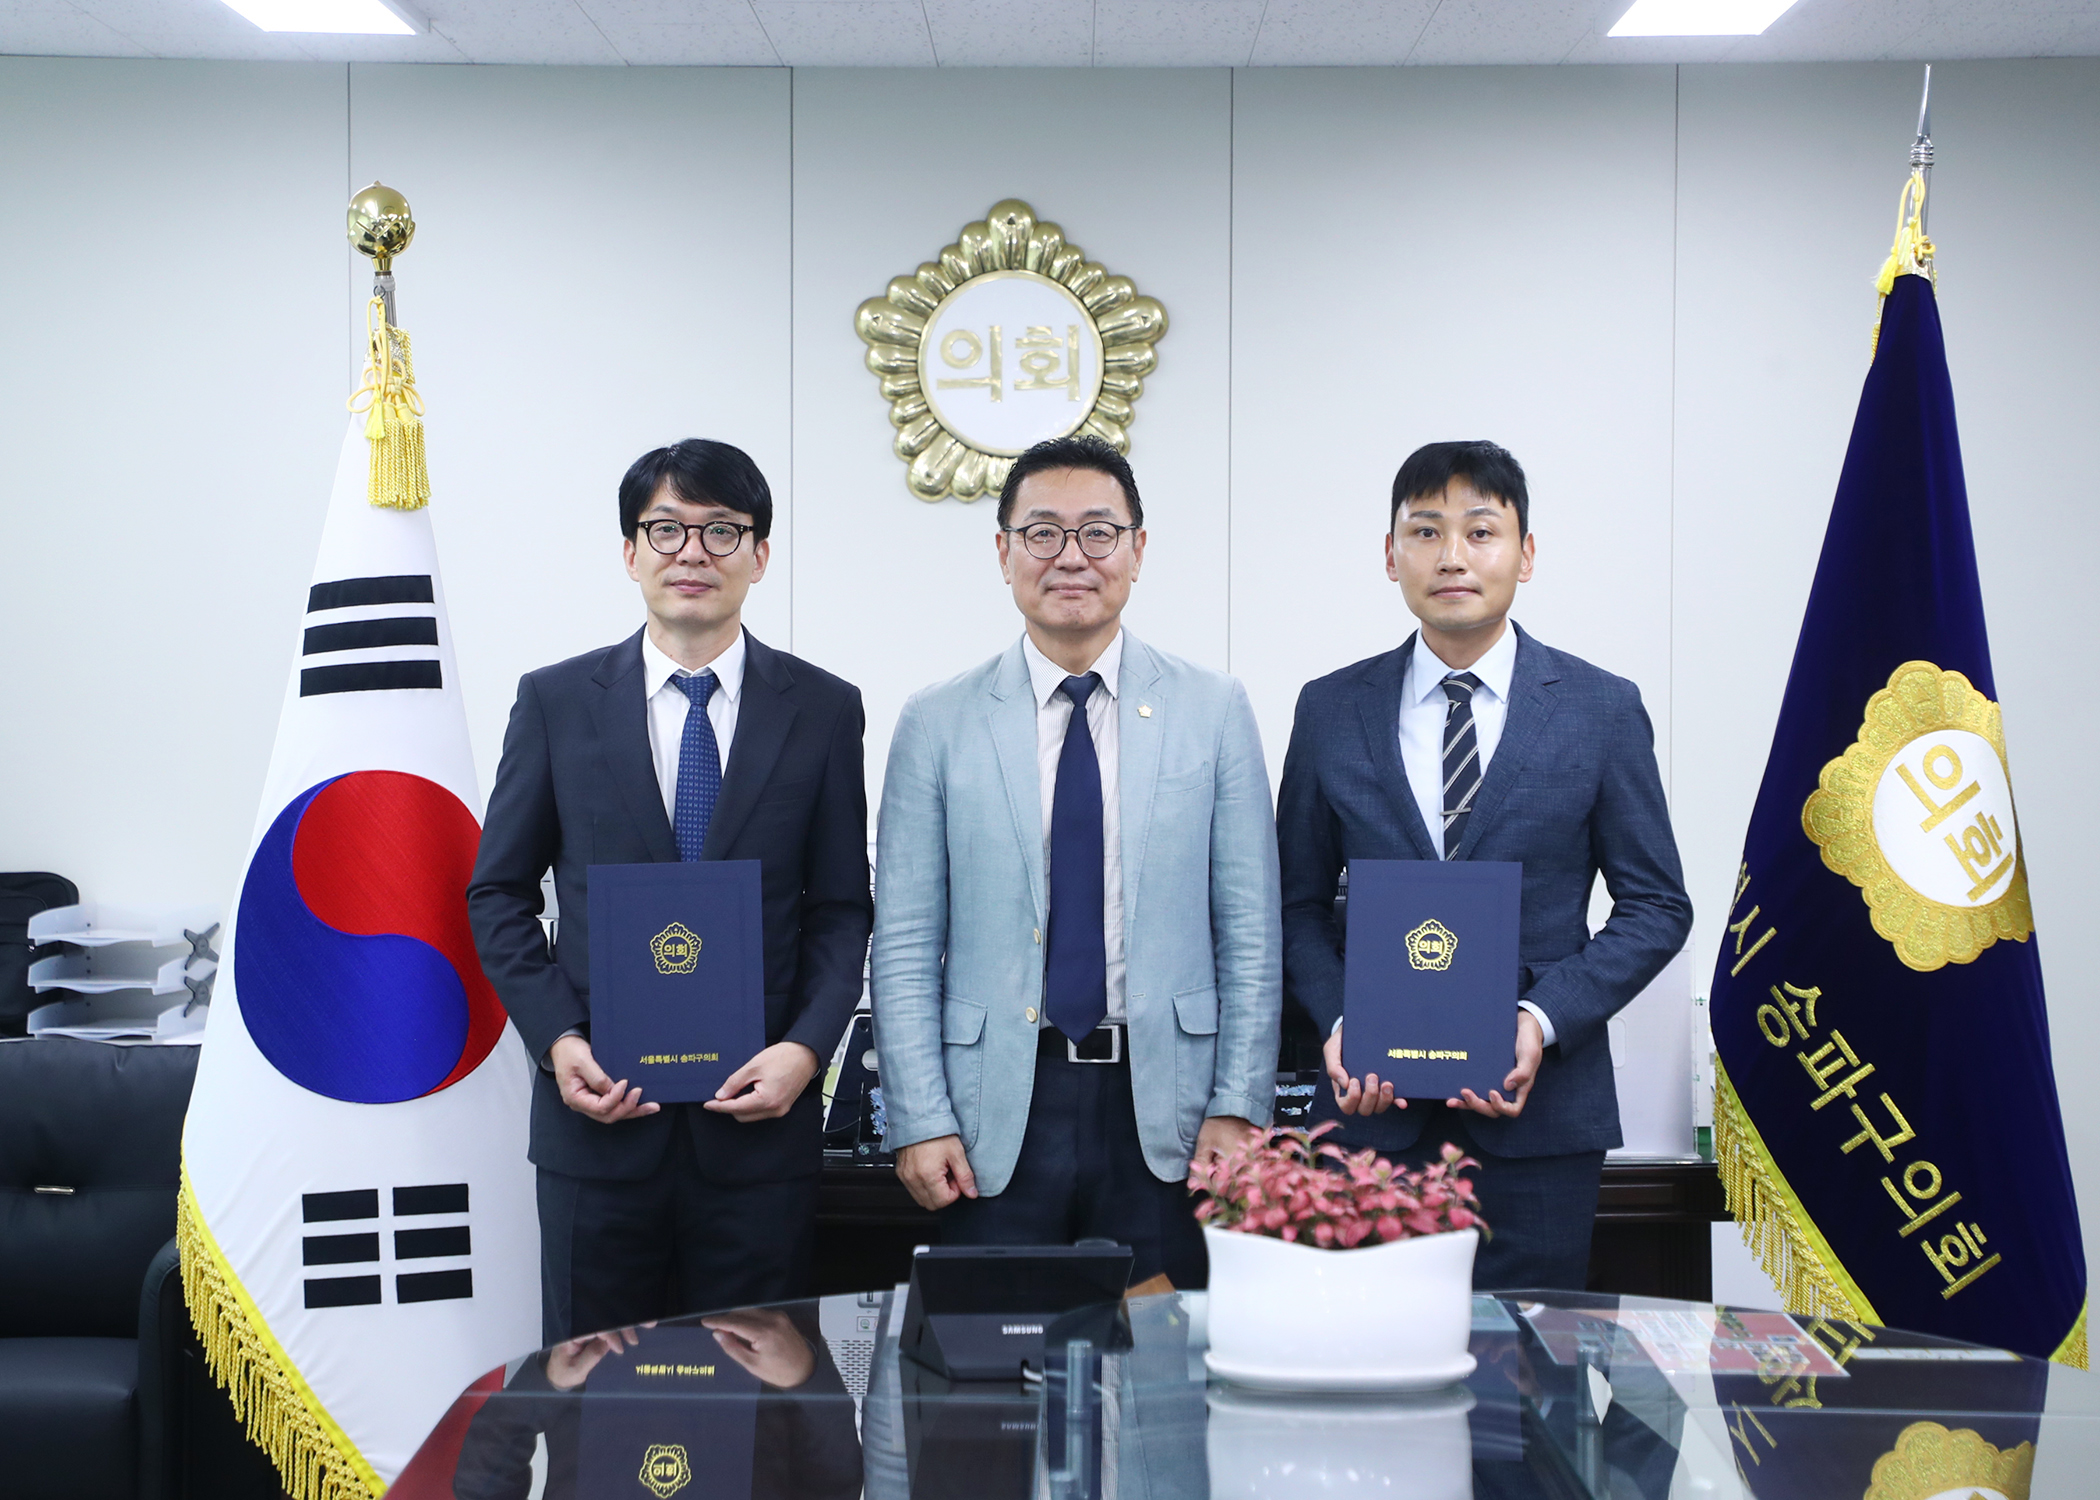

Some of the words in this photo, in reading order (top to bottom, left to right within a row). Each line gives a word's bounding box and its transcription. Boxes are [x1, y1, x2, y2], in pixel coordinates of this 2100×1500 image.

[936, 323, 1081, 403] 의회
[1895, 743, 2015, 903] 의회
[663, 943, 688, 958] 의회
[1418, 939, 1443, 955] 의회
[639, 1054, 678, 1065] 서울특별시
[680, 1052, 719, 1063] 송파구의회
[1387, 1048, 1427, 1060] 서울특별시
[1428, 1049, 1468, 1061] 송파구의회
[1756, 979, 2002, 1300] 송파구의회
[1002, 1324, 1044, 1335] SAMSUNG
